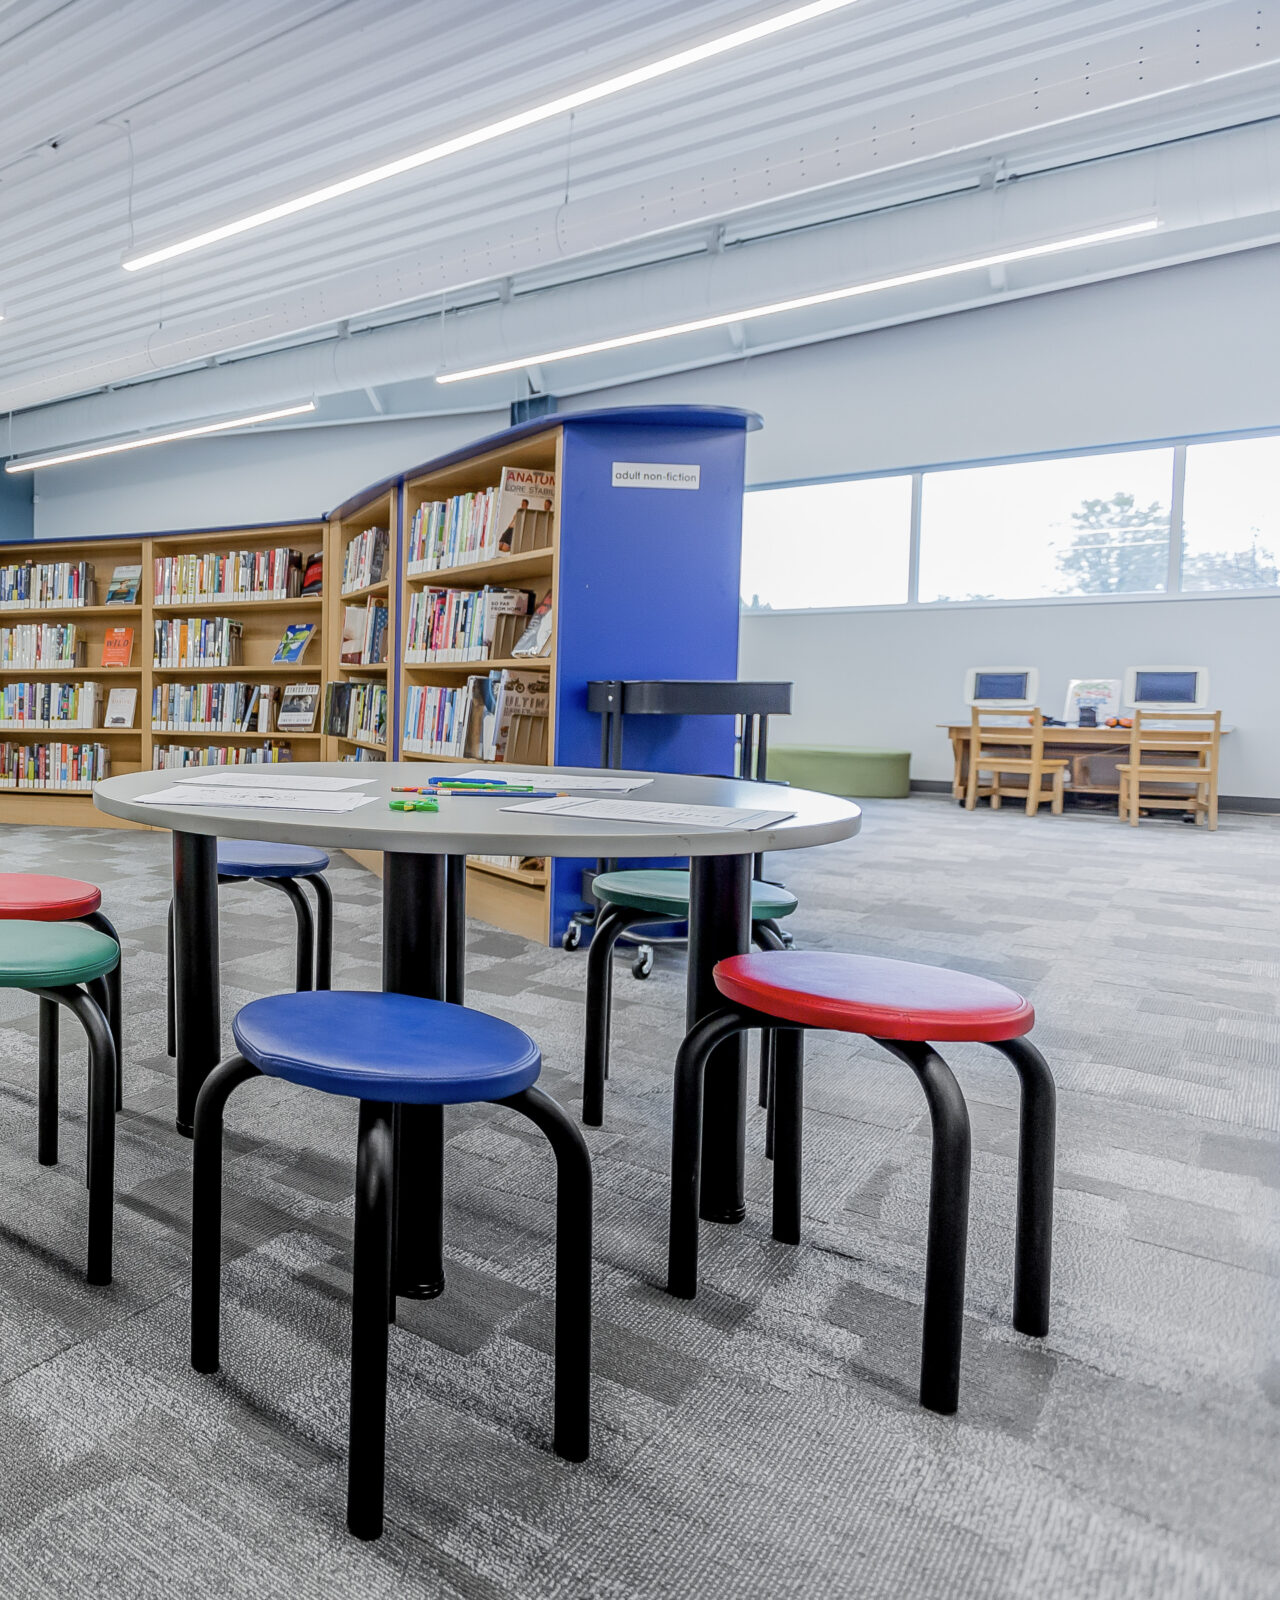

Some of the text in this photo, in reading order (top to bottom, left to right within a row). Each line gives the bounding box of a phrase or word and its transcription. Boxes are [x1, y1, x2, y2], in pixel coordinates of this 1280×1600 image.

[507, 471, 555, 486] ANATOM
[615, 471, 697, 482] adult non-fiction
[529, 486, 555, 496] STABIL
[106, 639, 129, 647] WILD
[505, 695, 549, 709] ULTIM
